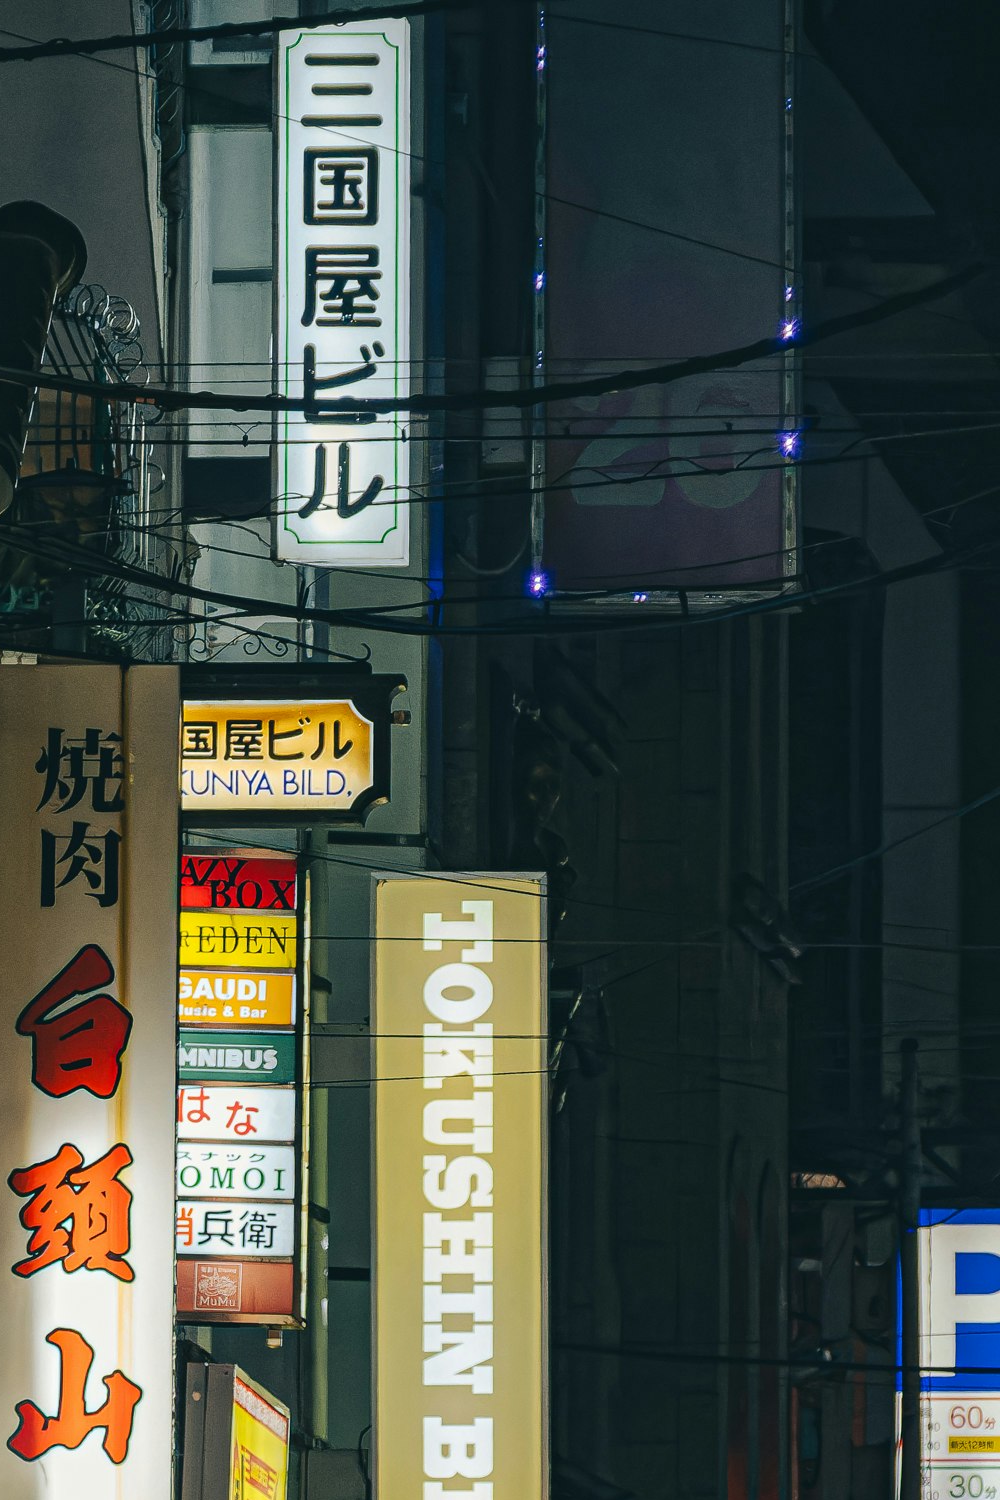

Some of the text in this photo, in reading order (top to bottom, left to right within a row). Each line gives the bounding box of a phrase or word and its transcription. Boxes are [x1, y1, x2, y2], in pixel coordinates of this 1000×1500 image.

[300, 53, 384, 519] 三国屋ビル
[181, 717, 353, 761] 国屋ビル
[35, 727, 125, 908] 焼肉
[210, 880, 295, 910] BOX
[196, 926, 289, 955] EDEN
[180, 976, 267, 1001] GAUDI
[222, 1005, 234, 1017] &
[239, 1006, 268, 1018] Bar
[177, 1151, 266, 1163] スナック
[422, 900, 495, 1395] TOKUSHIN
[919, 1222, 1000, 1378] P
